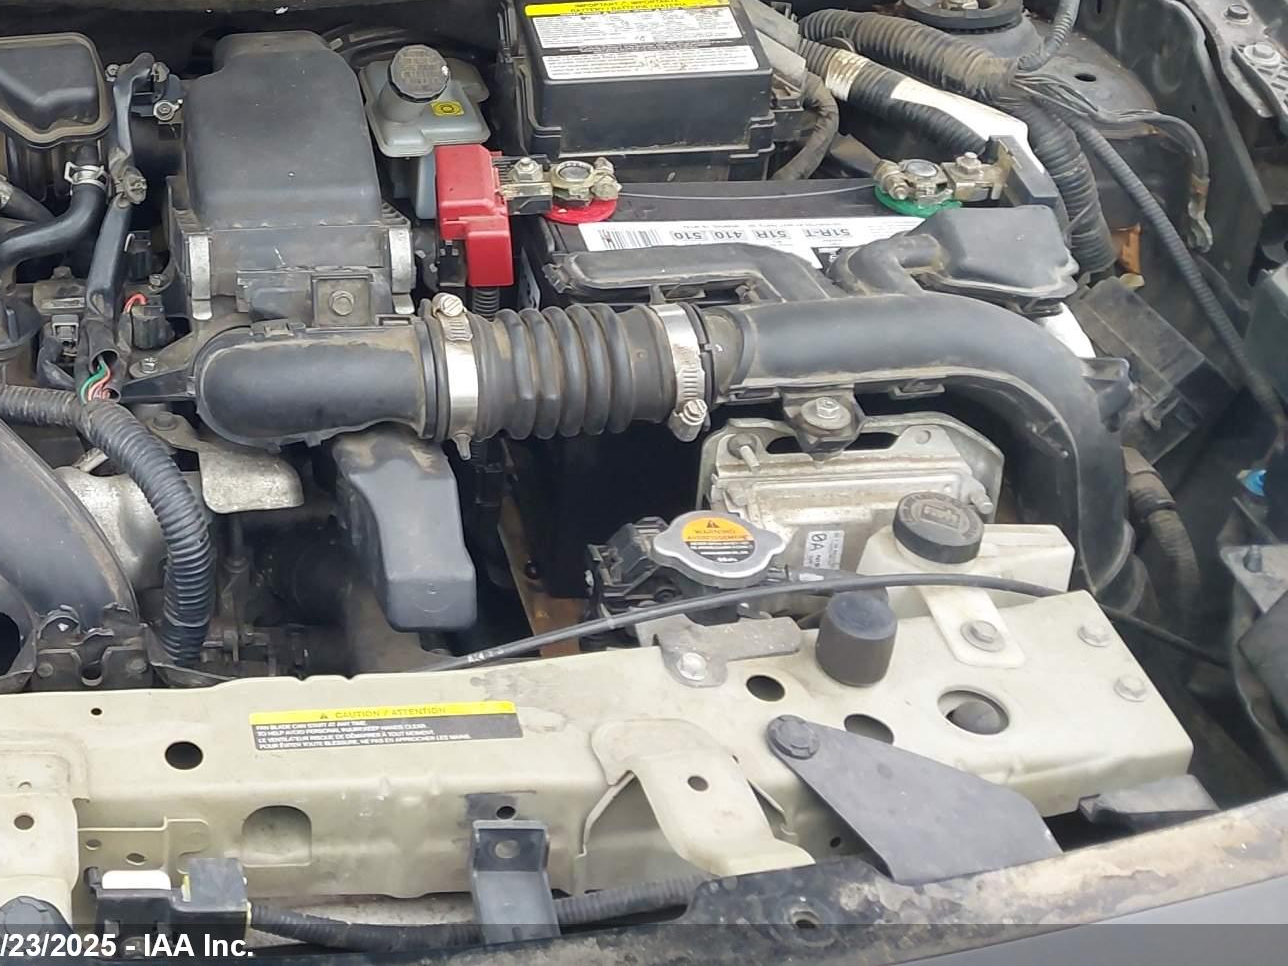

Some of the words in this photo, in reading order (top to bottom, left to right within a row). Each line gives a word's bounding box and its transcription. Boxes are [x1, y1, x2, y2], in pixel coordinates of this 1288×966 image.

[674, 232, 703, 240] 510
[714, 231, 743, 240] 410
[755, 230, 787, 239] 51R
[806, 228, 851, 238] 51R-T
[335, 709, 380, 719] CAUTION
[392, 706, 446, 716] ATTENTION
